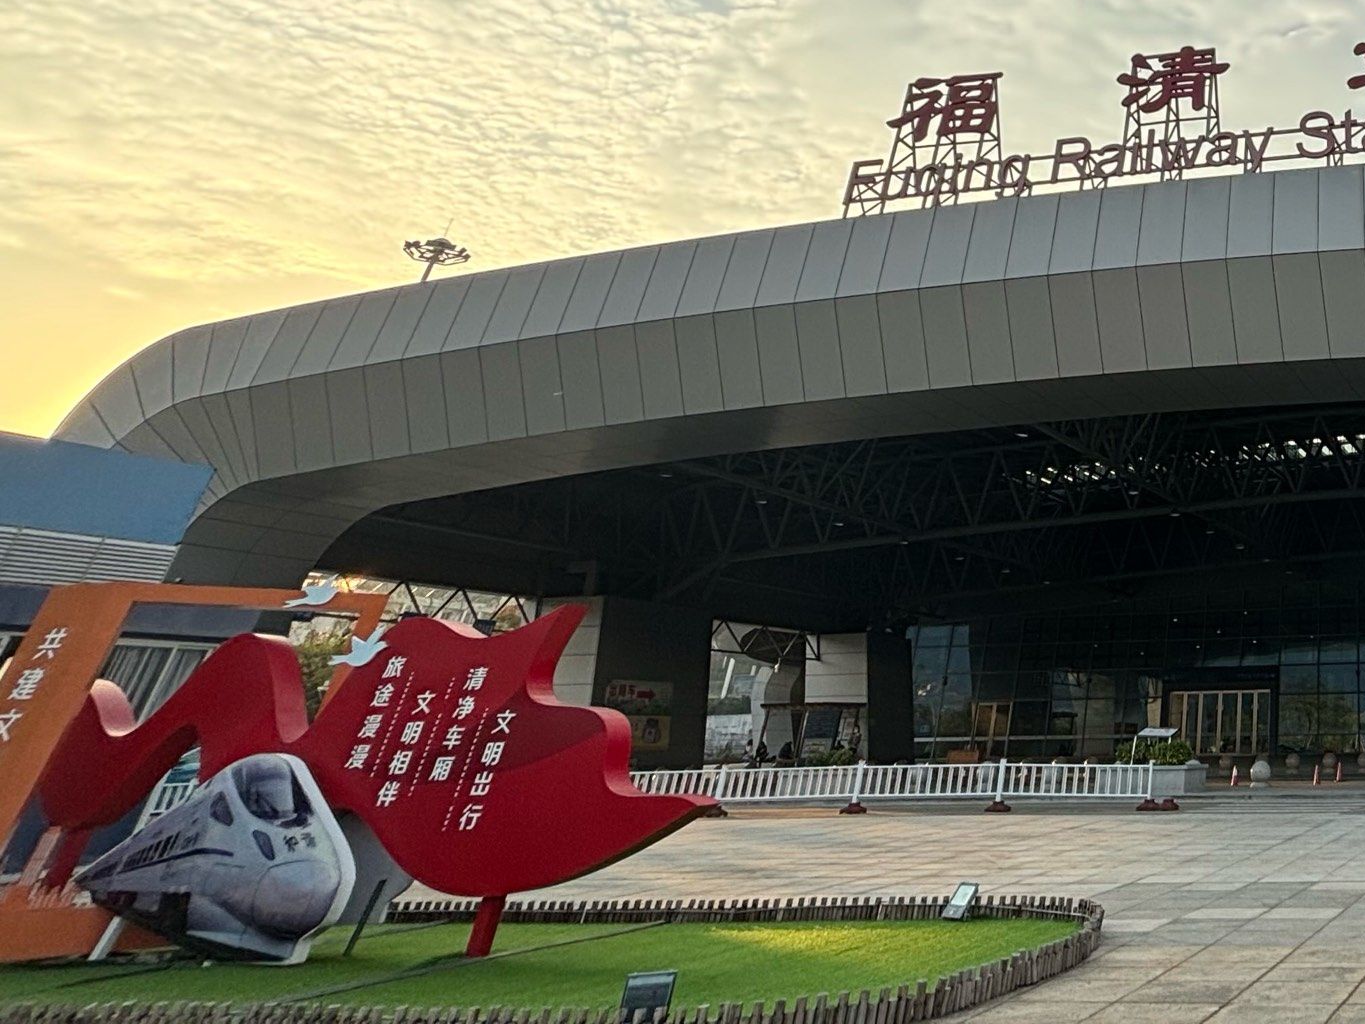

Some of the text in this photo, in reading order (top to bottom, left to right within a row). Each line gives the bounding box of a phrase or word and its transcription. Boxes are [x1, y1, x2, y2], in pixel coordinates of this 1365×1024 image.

[842, 153, 1031, 206] Fuqing
[1051, 127, 1274, 183] Railway
[344, 656, 408, 770] 旅途漫漫
[375, 690, 437, 808] 文明相伴
[428, 666, 489, 782] 清净车厢
[458, 708, 517, 831] 文明出行
